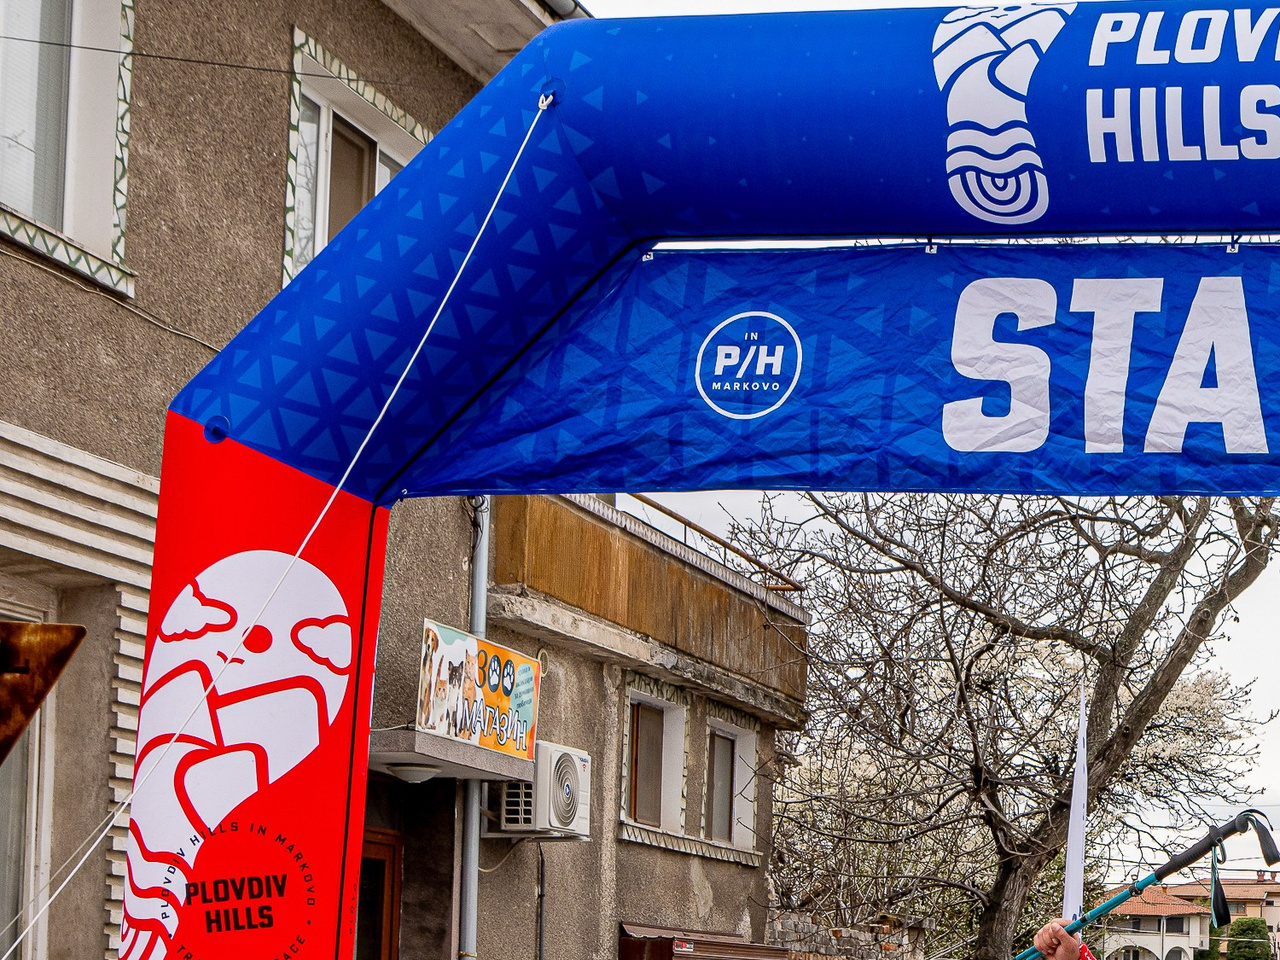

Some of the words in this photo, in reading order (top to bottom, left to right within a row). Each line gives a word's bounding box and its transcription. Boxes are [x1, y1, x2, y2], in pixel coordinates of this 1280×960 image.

[744, 332, 759, 341] IN
[714, 344, 784, 378] P/H
[711, 382, 781, 392] MARKOVO
[462, 698, 528, 751] МАГАЗИН
[250, 824, 267, 835] IN
[275, 834, 316, 906] MARKOVO
[185, 874, 287, 906] PLOVDIV
[205, 905, 274, 933] HILLS
